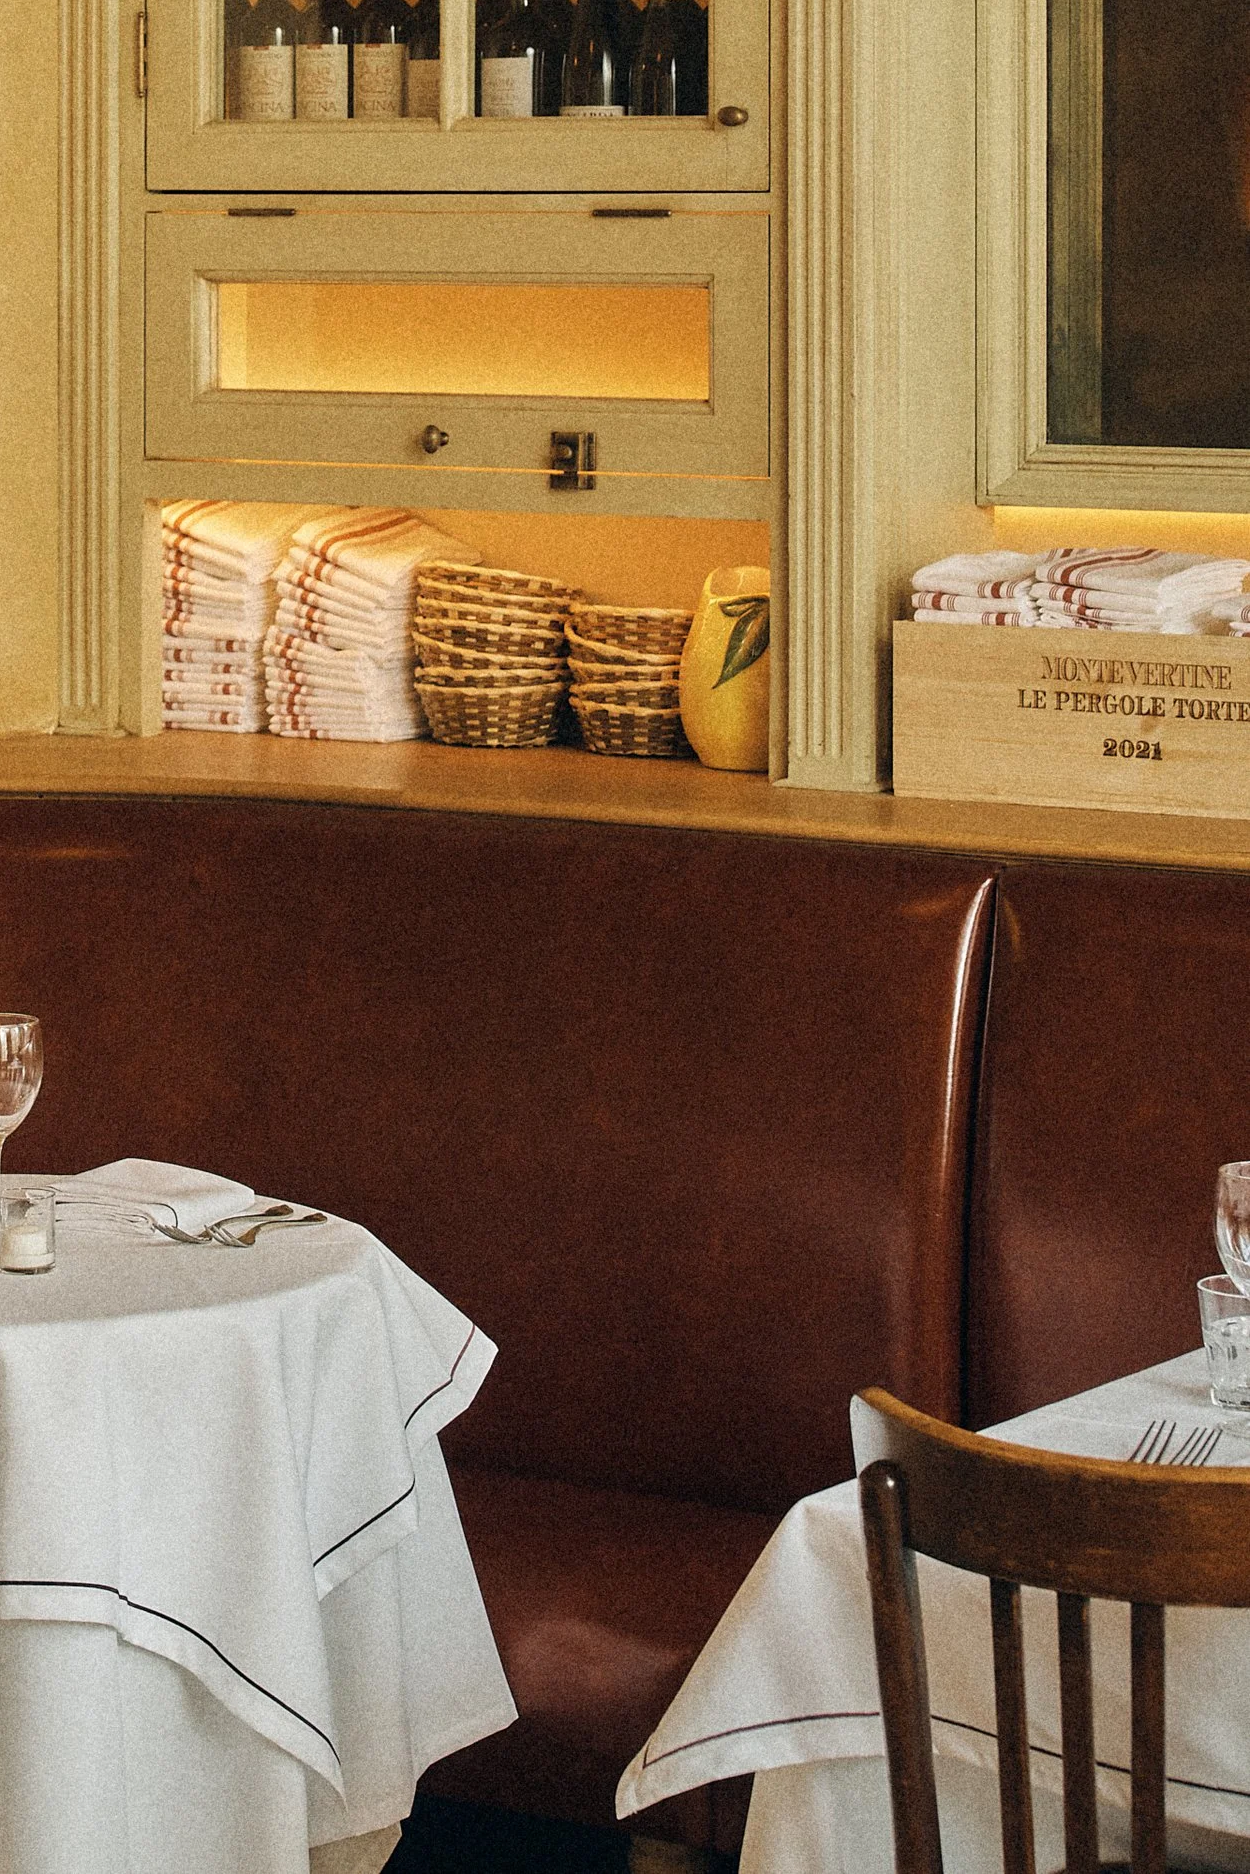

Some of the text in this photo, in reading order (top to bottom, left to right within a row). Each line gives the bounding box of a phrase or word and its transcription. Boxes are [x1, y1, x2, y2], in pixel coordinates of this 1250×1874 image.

[1040, 655, 1233, 691] MONTEVERTINE
[1017, 688, 1250, 723] LE PERGOLE TORTE
[1102, 737, 1164, 761] 2021
